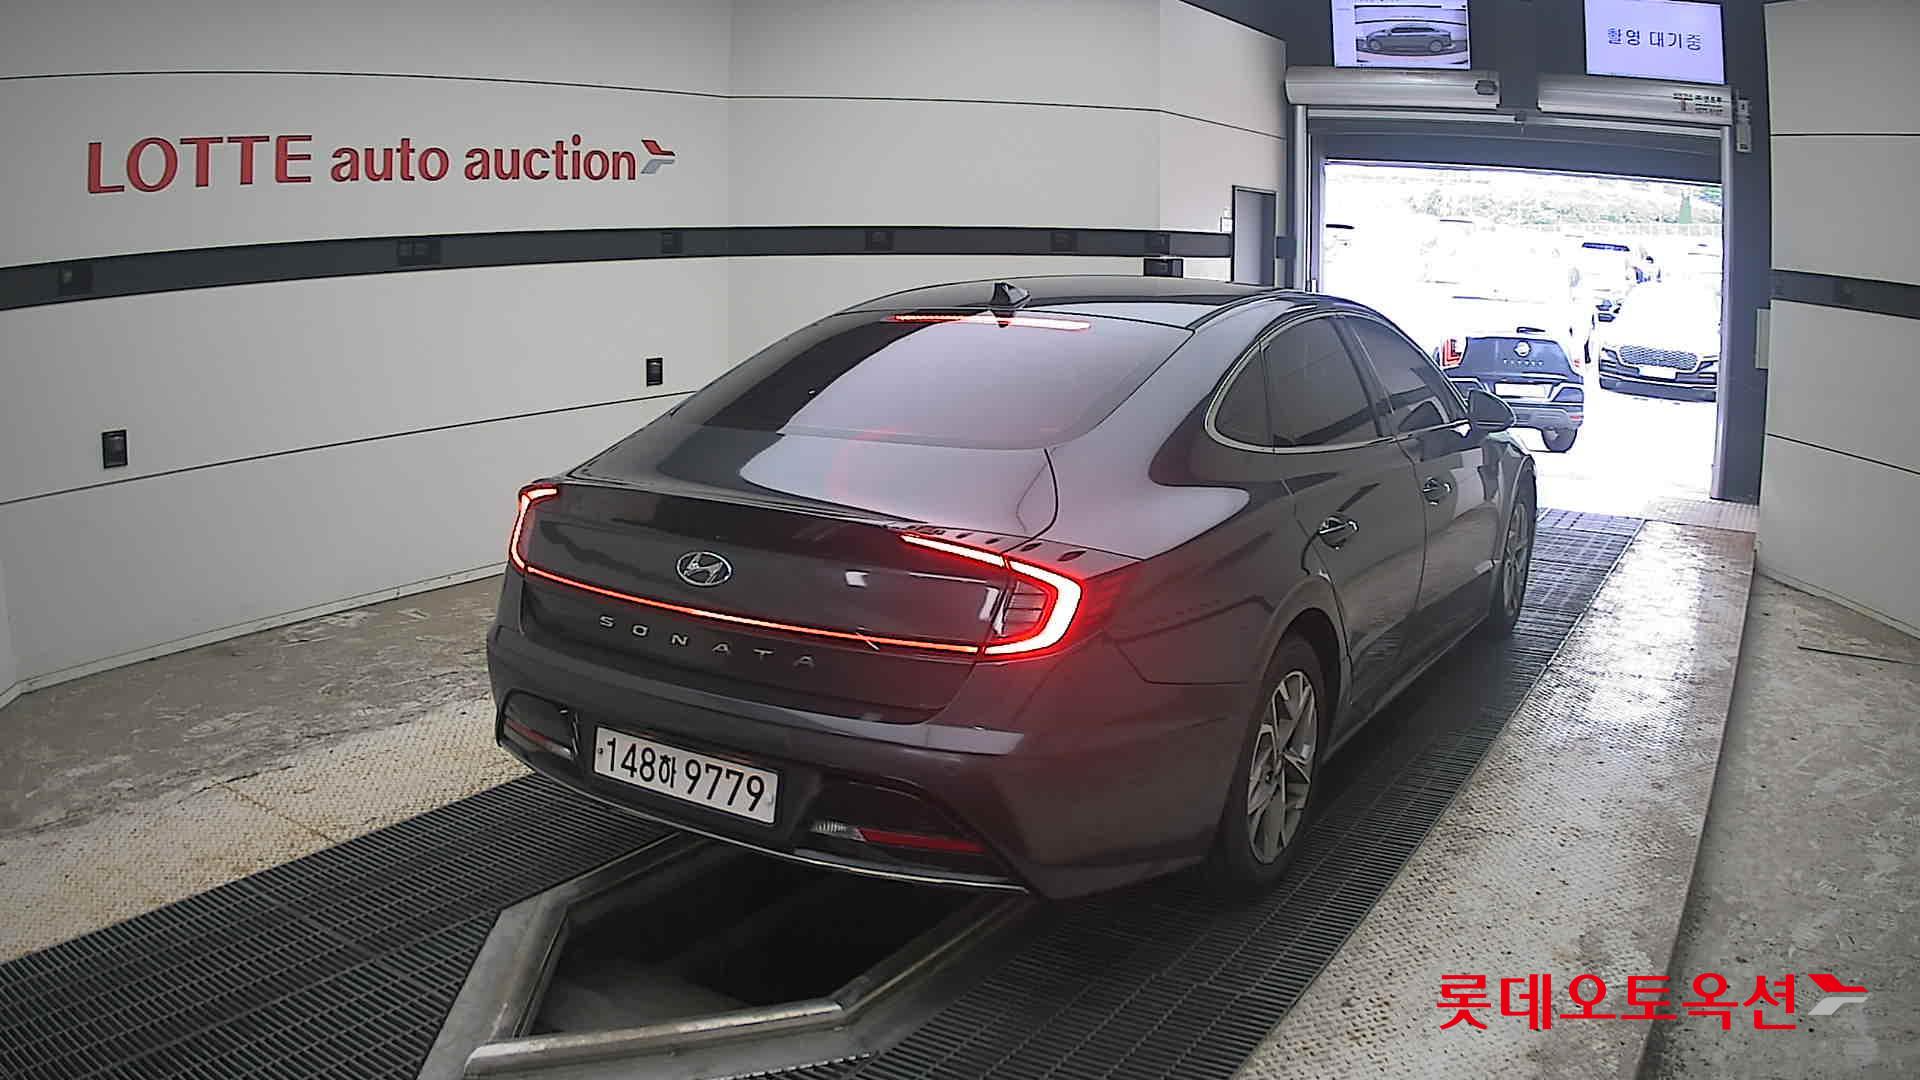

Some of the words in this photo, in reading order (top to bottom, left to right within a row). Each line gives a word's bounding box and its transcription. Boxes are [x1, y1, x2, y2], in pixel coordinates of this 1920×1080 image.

[1649, 31, 1701, 51] 대기중
[88, 134, 312, 194] LOTTE
[330, 137, 450, 183] auto
[463, 133, 638, 181] auction
[600, 615, 816, 669] SONATA
[685, 759, 766, 811] 9779
